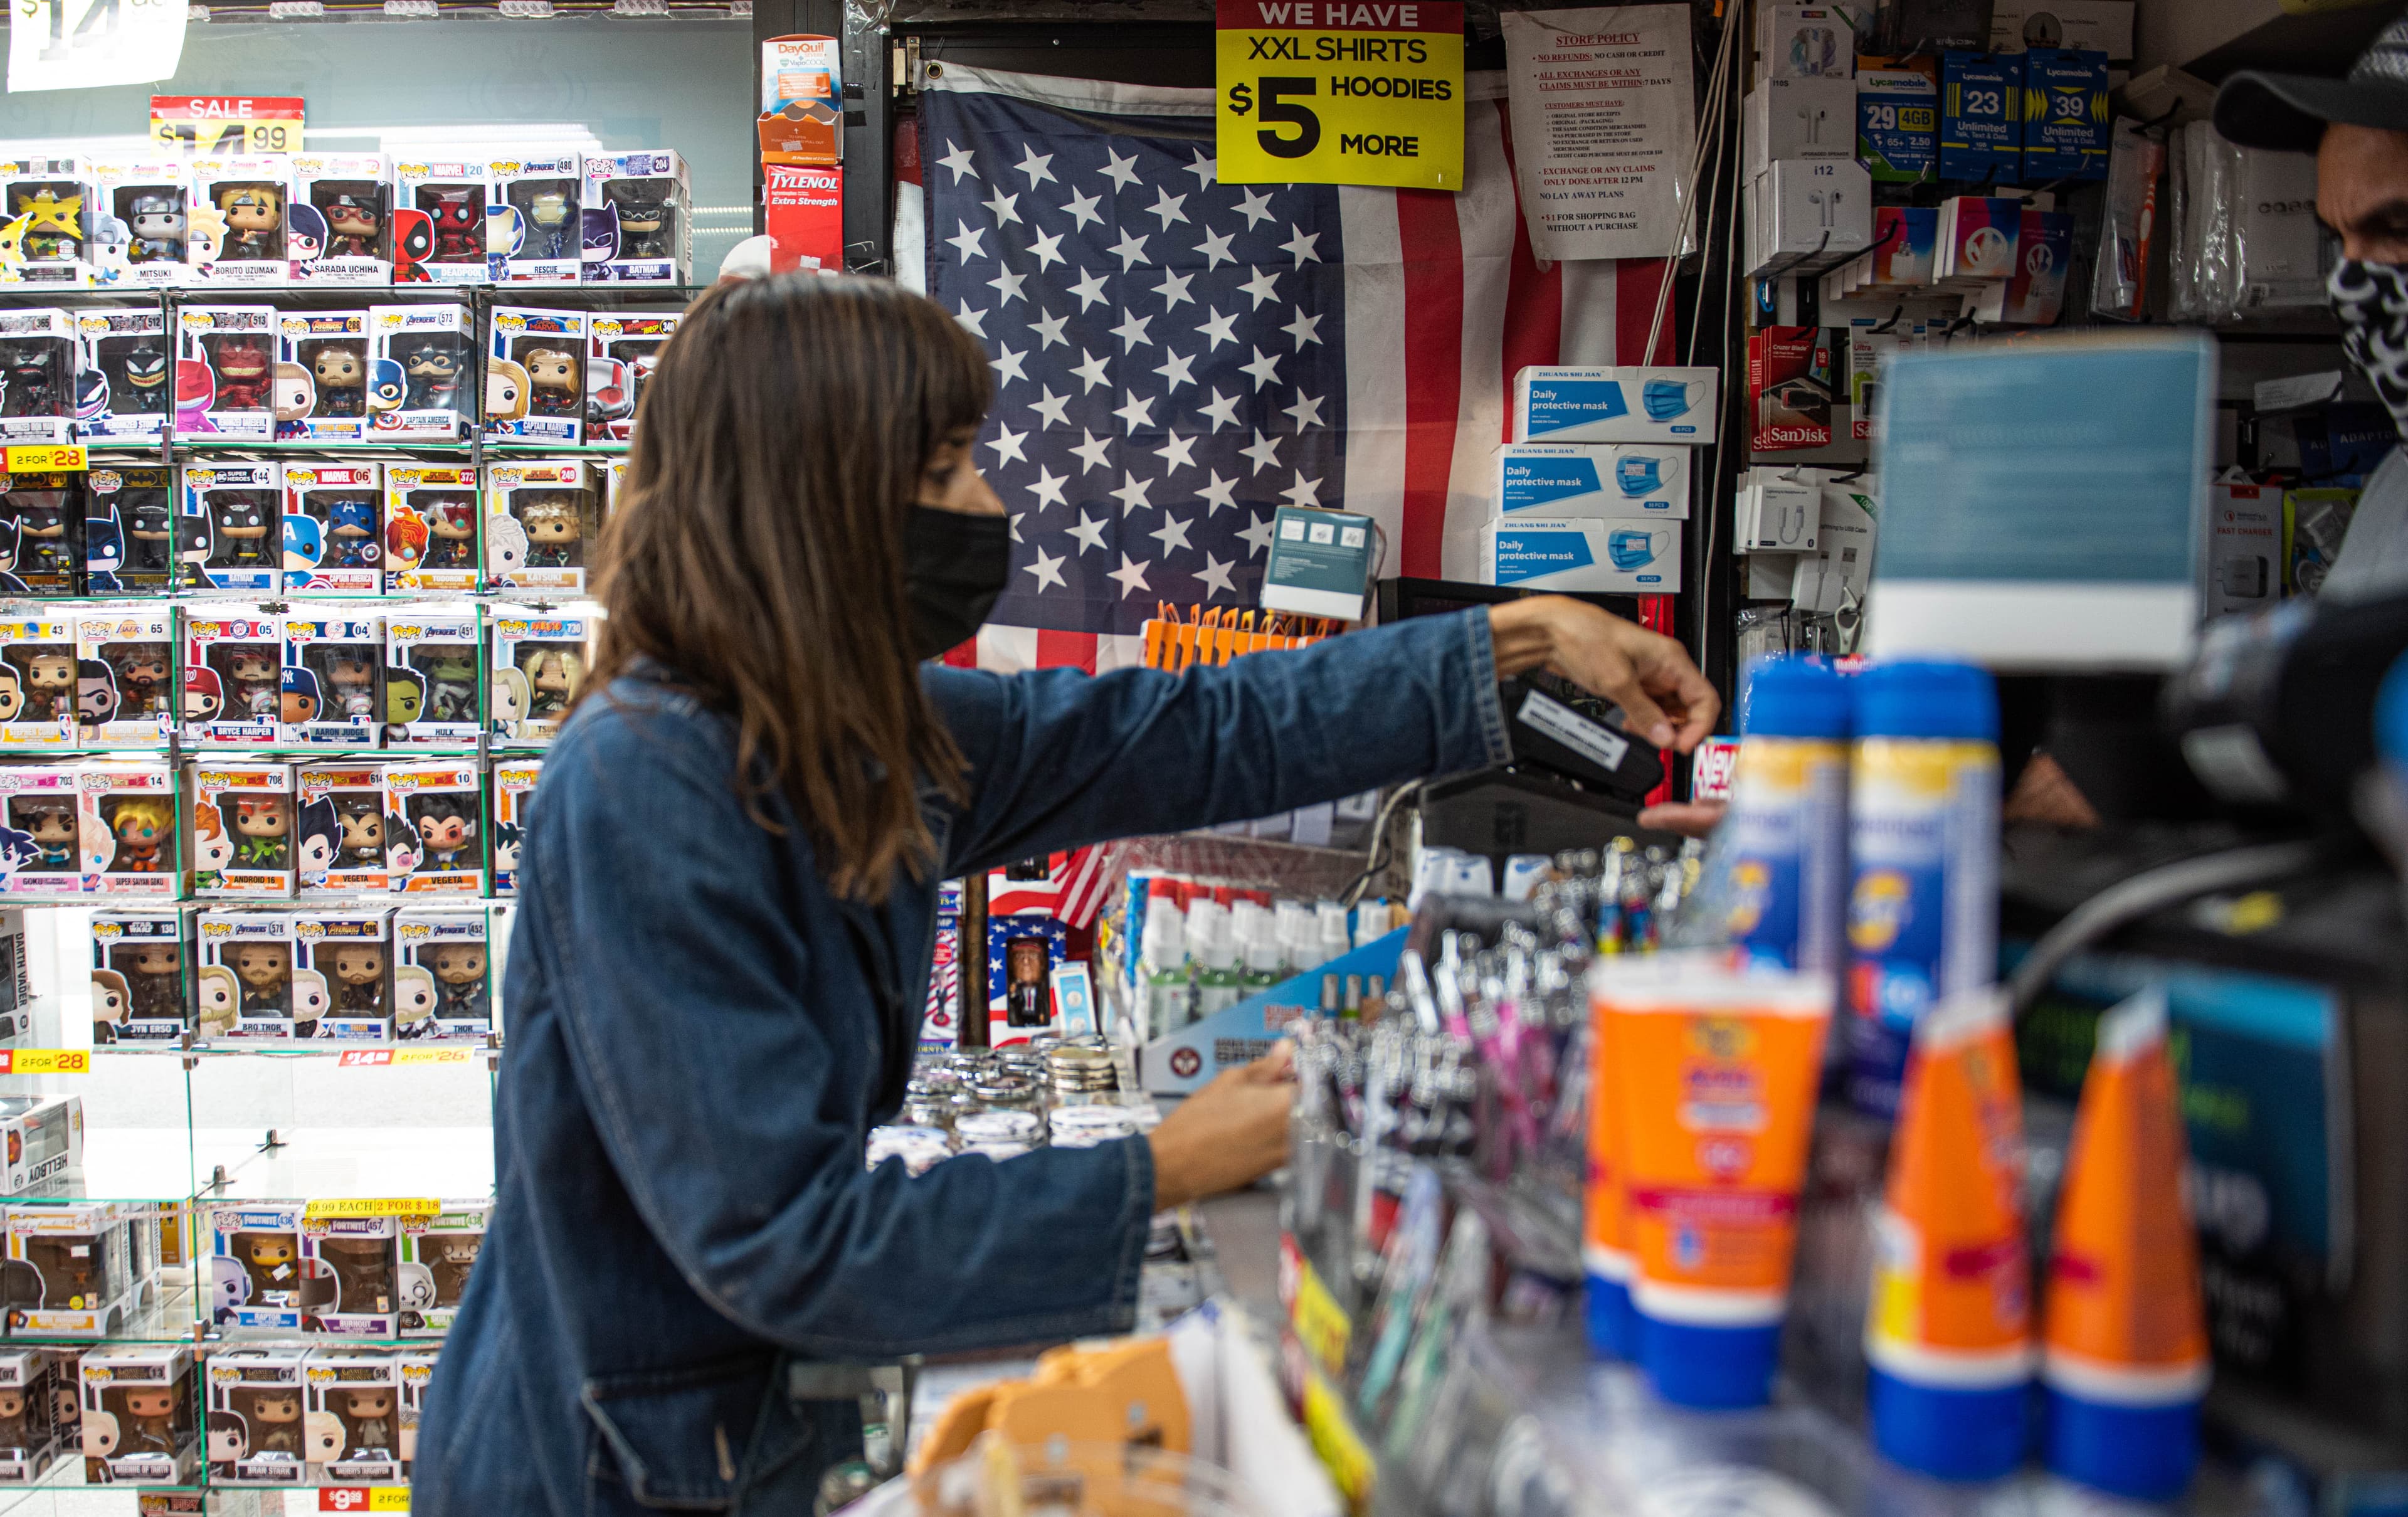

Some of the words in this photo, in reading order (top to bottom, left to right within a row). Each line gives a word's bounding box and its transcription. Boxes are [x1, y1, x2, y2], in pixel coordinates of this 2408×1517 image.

[1258, 3, 1313, 24] WE
[1326, 4, 1418, 27] HAVE
[1556, 34, 1595, 46] STORE
[1597, 33, 1640, 44] POLICY
[779, 43, 824, 56] DayQuil
[1248, 36, 1311, 60] XXL
[1315, 36, 1427, 63] SHIRTS
[1551, 53, 1592, 61] REFUNDS:
[1557, 70, 1608, 78] EXCHANGES
[1963, 72, 2003, 82] Lycamobile
[2047, 68, 2093, 78] Lycamobile
[1331, 76, 1452, 100] HOODIES
[1869, 78, 1926, 88] Lycamobile
[189, 100, 253, 119] SALE
[1901, 110, 1931, 125] 4GB
[1958, 121, 2007, 133] Unlimited
[2044, 126, 2093, 138] Unlimited
[253, 126, 286, 150] 99
[1341, 134, 1418, 157] MORE
[433, 165, 464, 177] MARVEL
[1543, 167, 1588, 176] EXCHANGE
[1623, 164, 1656, 172] CLAIMS
[1814, 166, 1834, 175] i12
[771, 173, 837, 190] TYLENOL
[771, 197, 797, 205] Extra
[799, 198, 838, 206] Strength
[1576, 212, 1617, 220] SHOPPING
[1619, 211, 1635, 219] BAG
[1546, 224, 1585, 232] WITHOUT
[1595, 223, 1638, 231] PURCHASE
[1532, 390, 1556, 401] Daily
[1532, 401, 1580, 411] protective
[1583, 401, 1608, 410] mask
[523, 421, 544, 430] CAPTAIN
[547, 423, 568, 432] MARVEL
[1771, 428, 1828, 442] SanDisk
[2340, 430, 2398, 443] ADAPTO
[17, 456, 23, 464] 2
[26, 456, 48, 464] FOR
[322, 472, 350, 482] MARVEL
[1506, 467, 1531, 477] Daily
[1506, 478, 1555, 487] protective
[1556, 478, 1582, 486] mask
[1499, 541, 1523, 551] Daily
[1499, 552, 1547, 561] protective
[1549, 552, 1574, 560] mask
[218, 727, 240, 736] BRYCE
[242, 727, 271, 736] HARPER
[431, 876, 463, 884] VEGETA
[15, 933, 26, 968] DARTH
[17, 971, 28, 1007] VADER
[28, 1153, 68, 1184] HELLBOY
[305, 1202, 335, 1212] $9.99
[339, 1201, 372, 1211] EACH
[377, 1202, 383, 1211] 2
[388, 1201, 413, 1211] FOR
[426, 1200, 439, 1210] 18
[244, 1217, 277, 1225] FORTNITE
[332, 1221, 367, 1231] FORTNITE
[247, 1466, 266, 1474] BRAN
[268, 1466, 291, 1474] STARK
